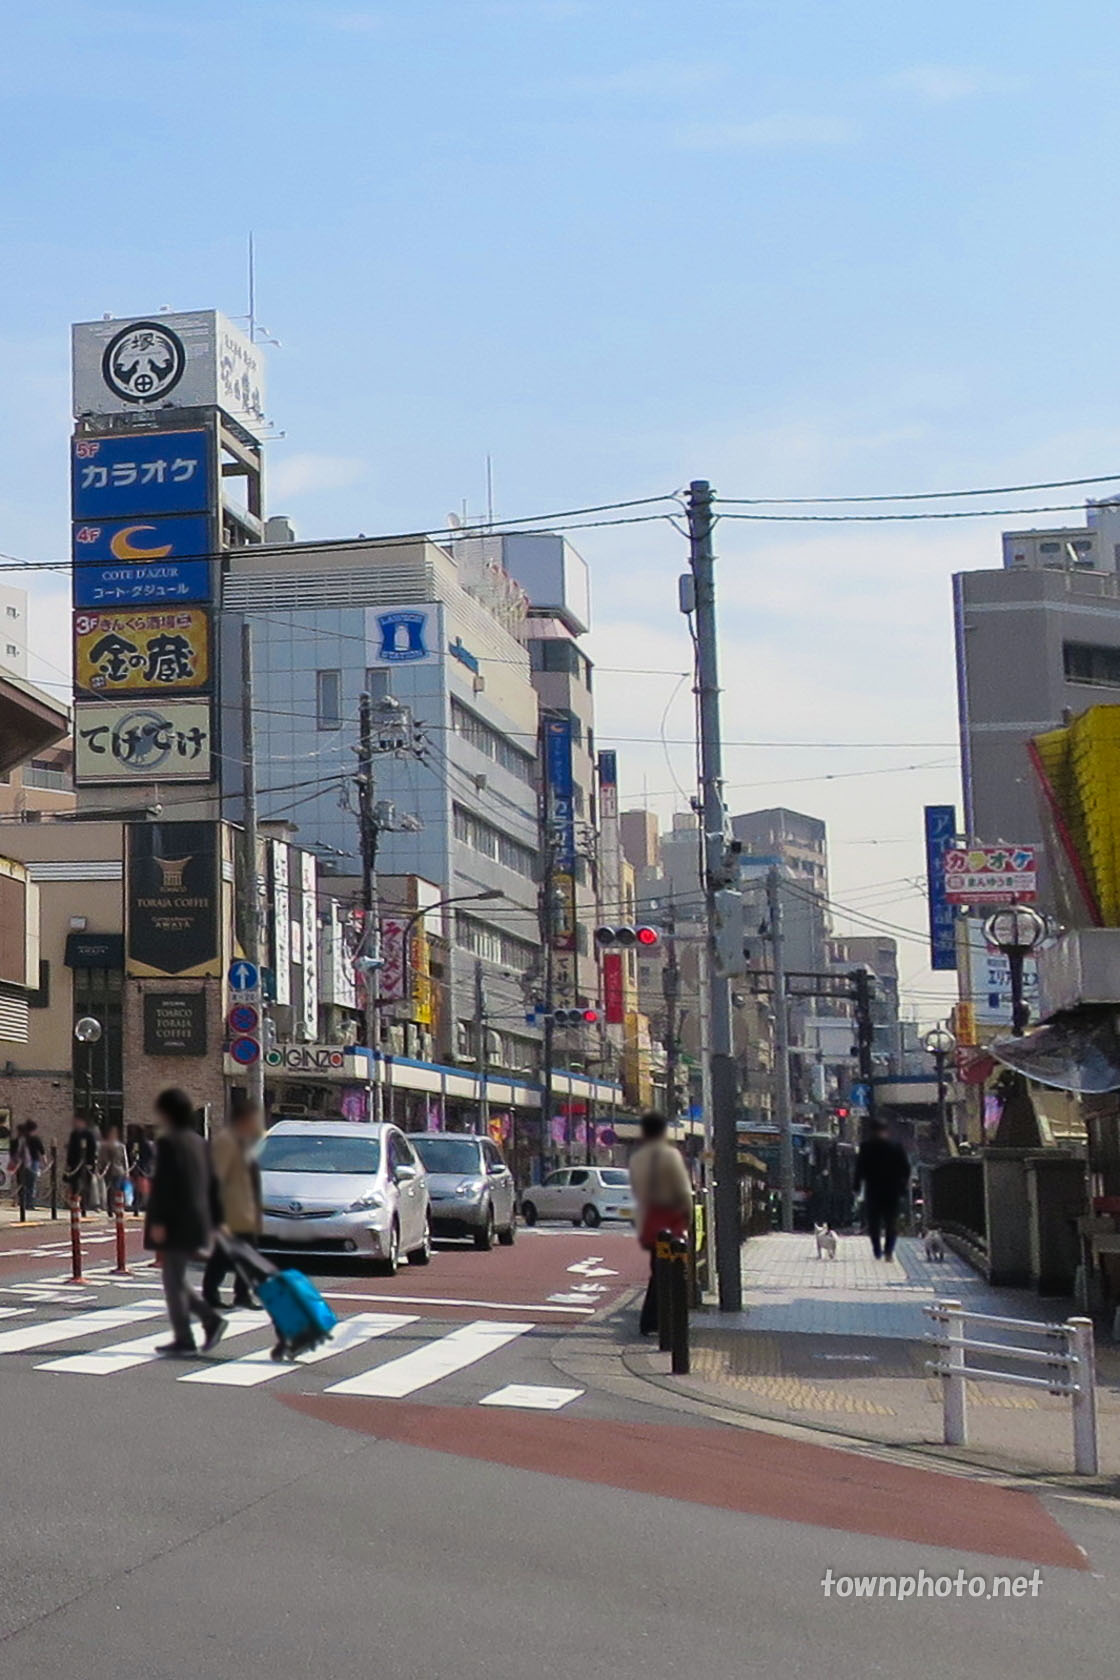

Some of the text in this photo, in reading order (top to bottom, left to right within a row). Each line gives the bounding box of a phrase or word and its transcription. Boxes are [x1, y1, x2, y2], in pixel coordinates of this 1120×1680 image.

[76, 441, 100, 459] 5F
[81, 457, 199, 490] カラオケ
[76, 526, 101, 544] 4F
[76, 615, 98, 634] 3F
[89, 632, 195, 683] 金の蔵
[81, 722, 207, 761] てけてけ
